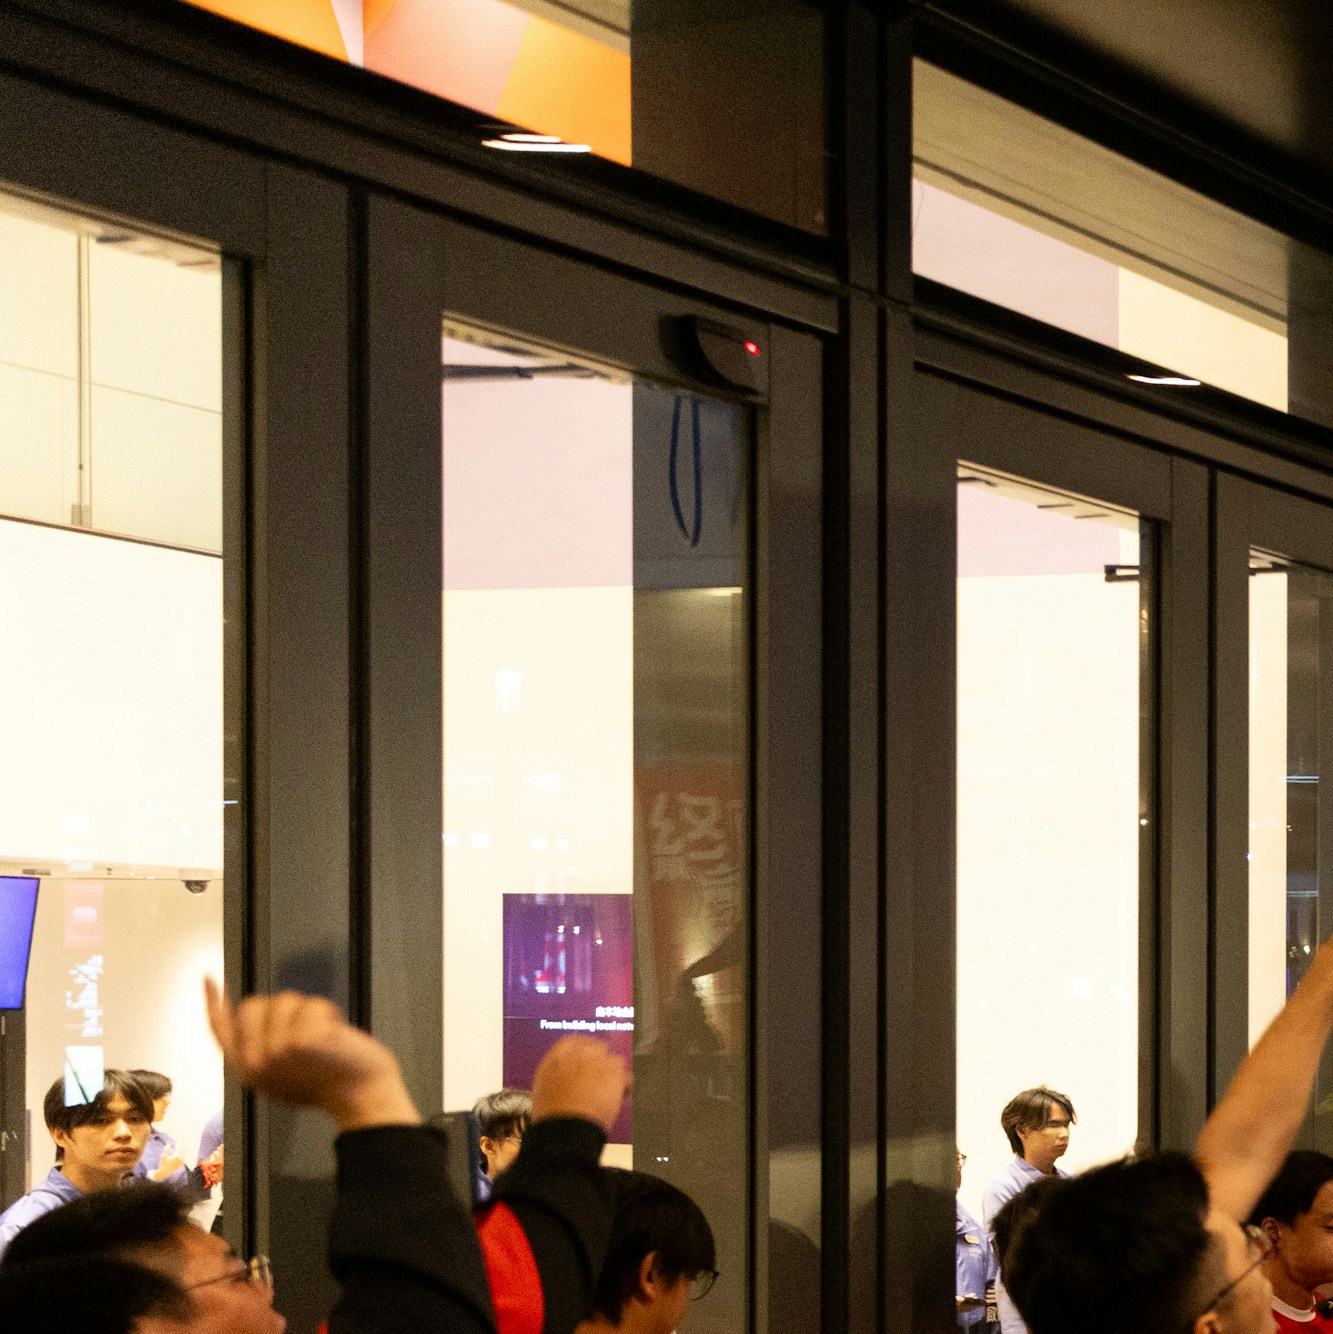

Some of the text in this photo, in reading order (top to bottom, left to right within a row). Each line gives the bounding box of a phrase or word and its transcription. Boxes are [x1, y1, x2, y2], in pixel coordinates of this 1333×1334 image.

[540, 1020, 562, 1029] From
[562, 1020, 596, 1031] building
[596, 1021, 616, 1030] local
